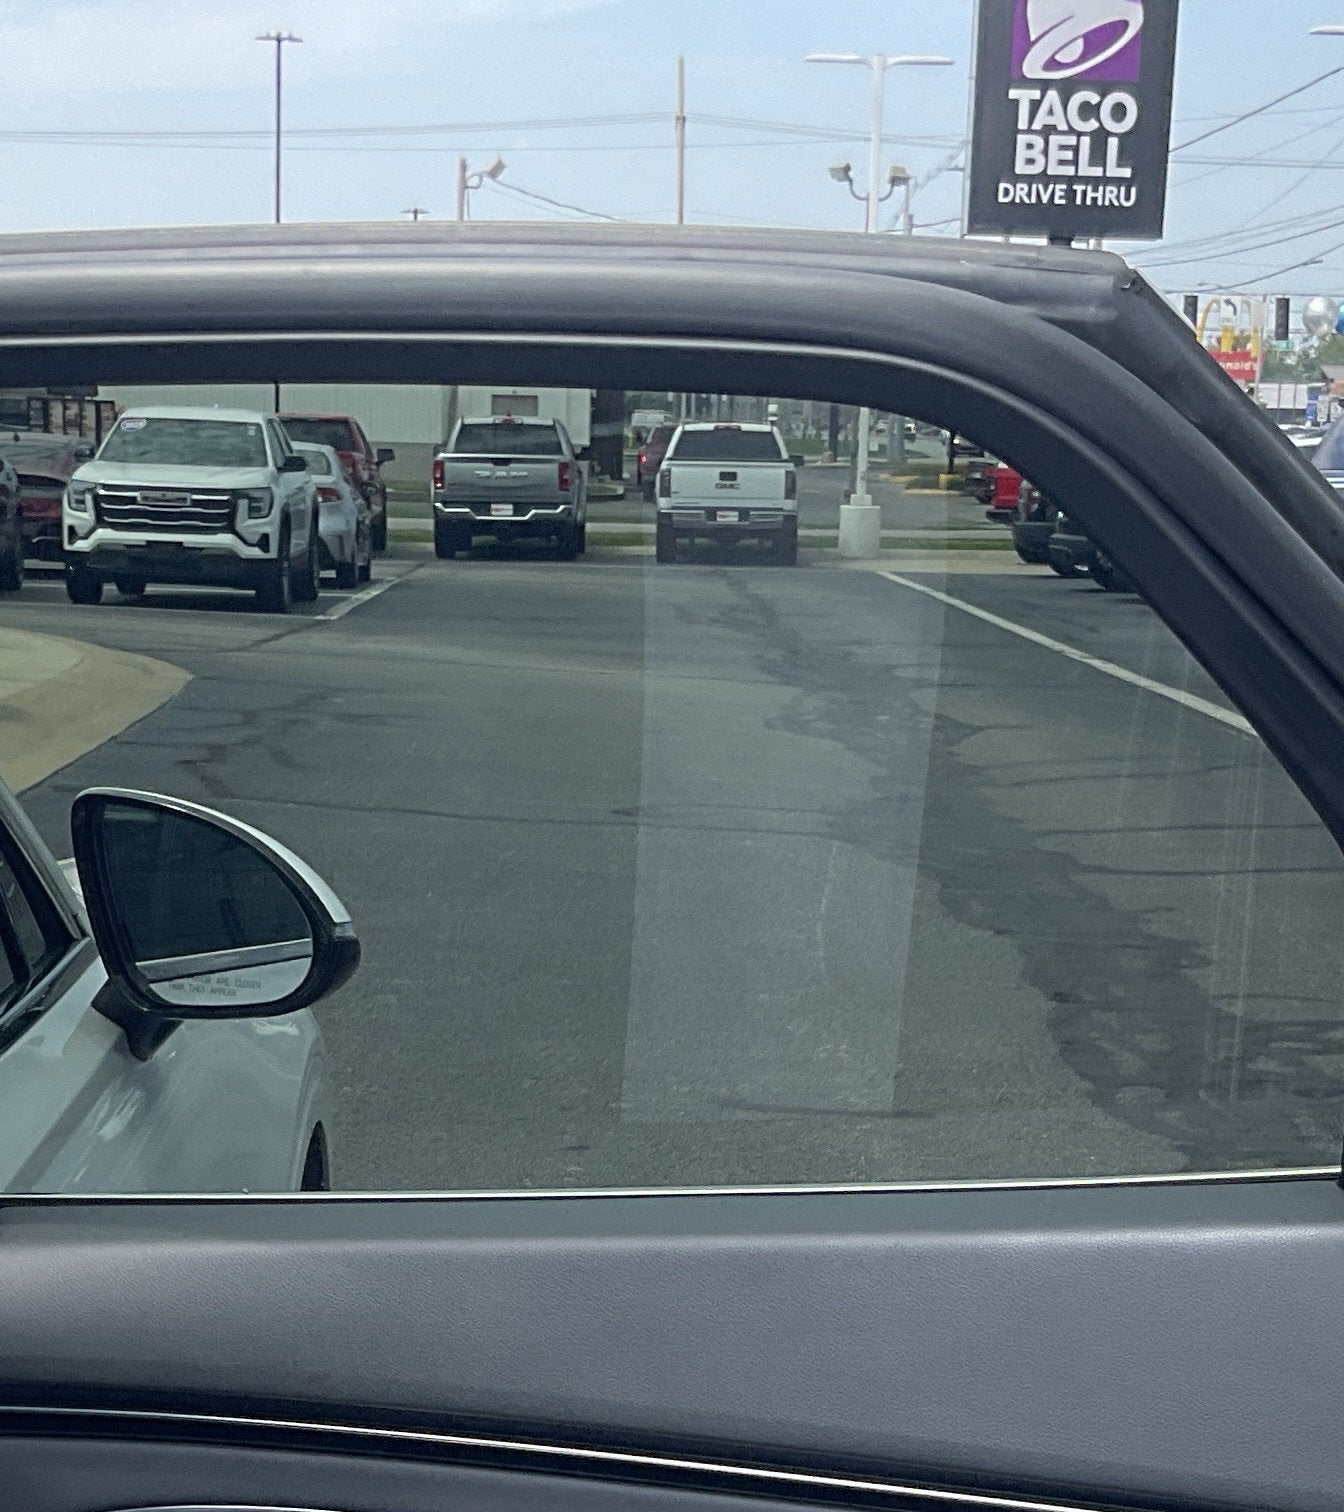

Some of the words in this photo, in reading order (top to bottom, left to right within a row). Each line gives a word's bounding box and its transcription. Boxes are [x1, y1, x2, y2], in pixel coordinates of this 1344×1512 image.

[1008, 88, 1138, 134] TACO
[1014, 133, 1132, 178] BELL
[997, 182, 1067, 205] DRIVE
[1072, 184, 1136, 207] THRU
